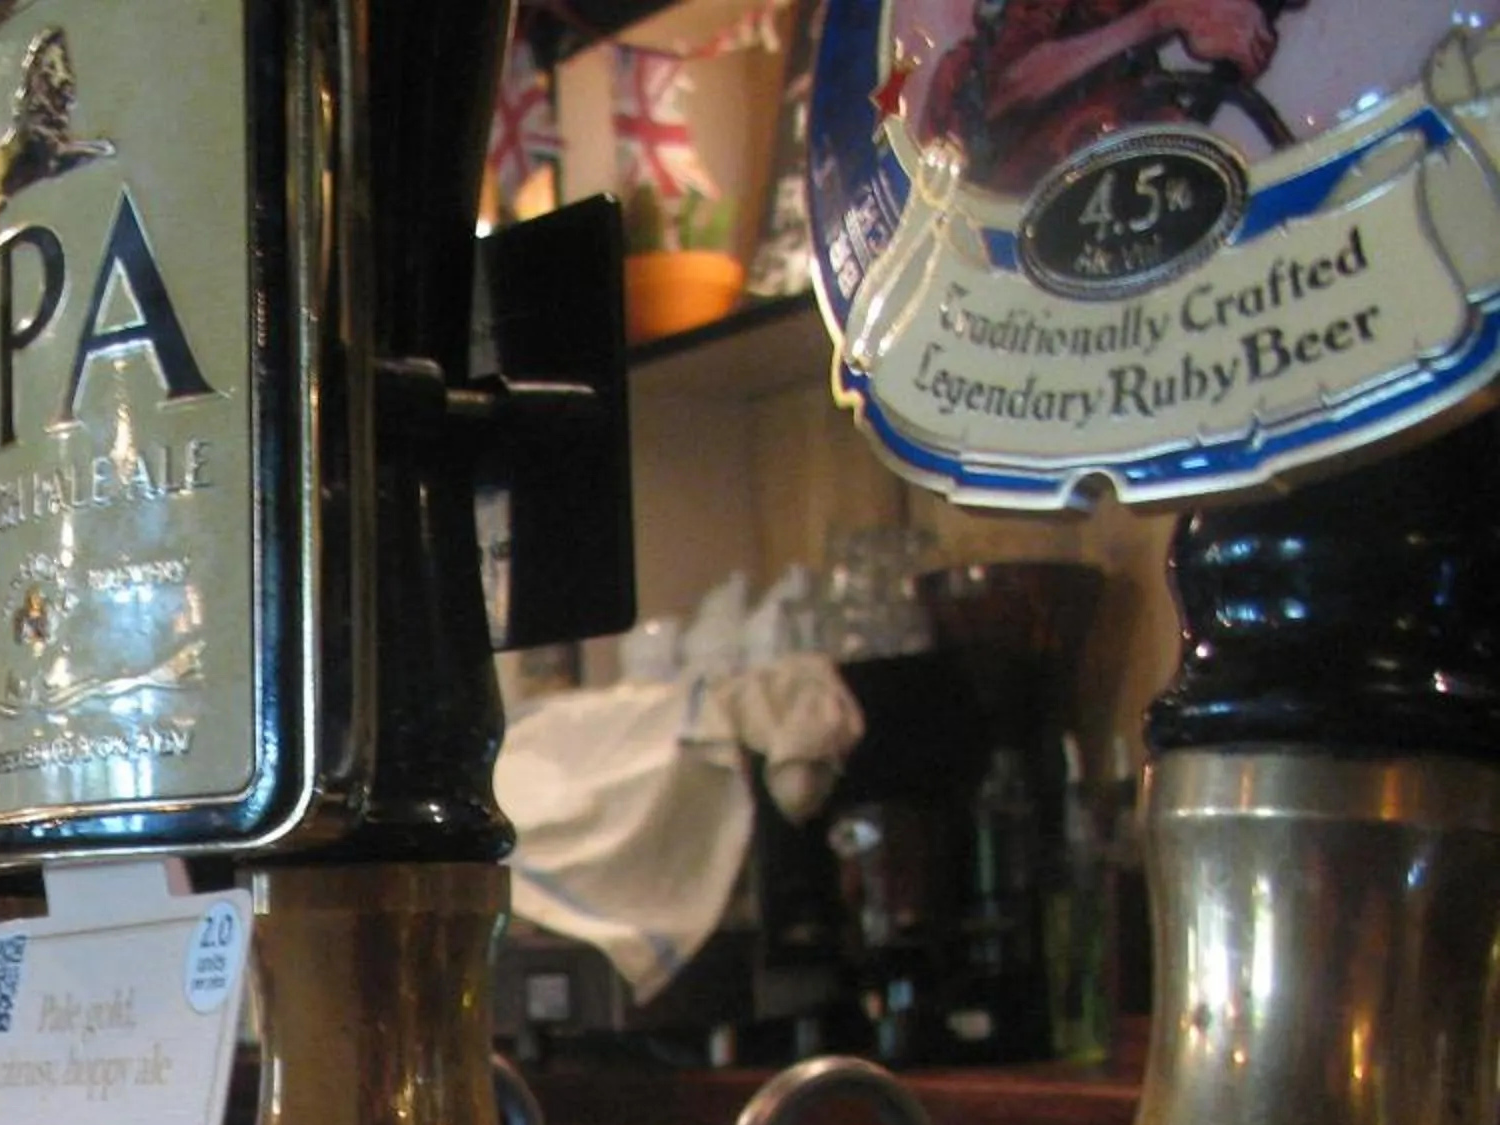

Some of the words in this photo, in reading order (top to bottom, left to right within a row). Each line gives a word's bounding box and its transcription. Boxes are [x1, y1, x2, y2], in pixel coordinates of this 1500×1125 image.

[938, 281, 1170, 358] Traditionally
[1179, 225, 1369, 333] Crafted
[913, 342, 1096, 428] Legendary
[1107, 350, 1240, 418] Ruby
[1240, 304, 1381, 384] Beer
